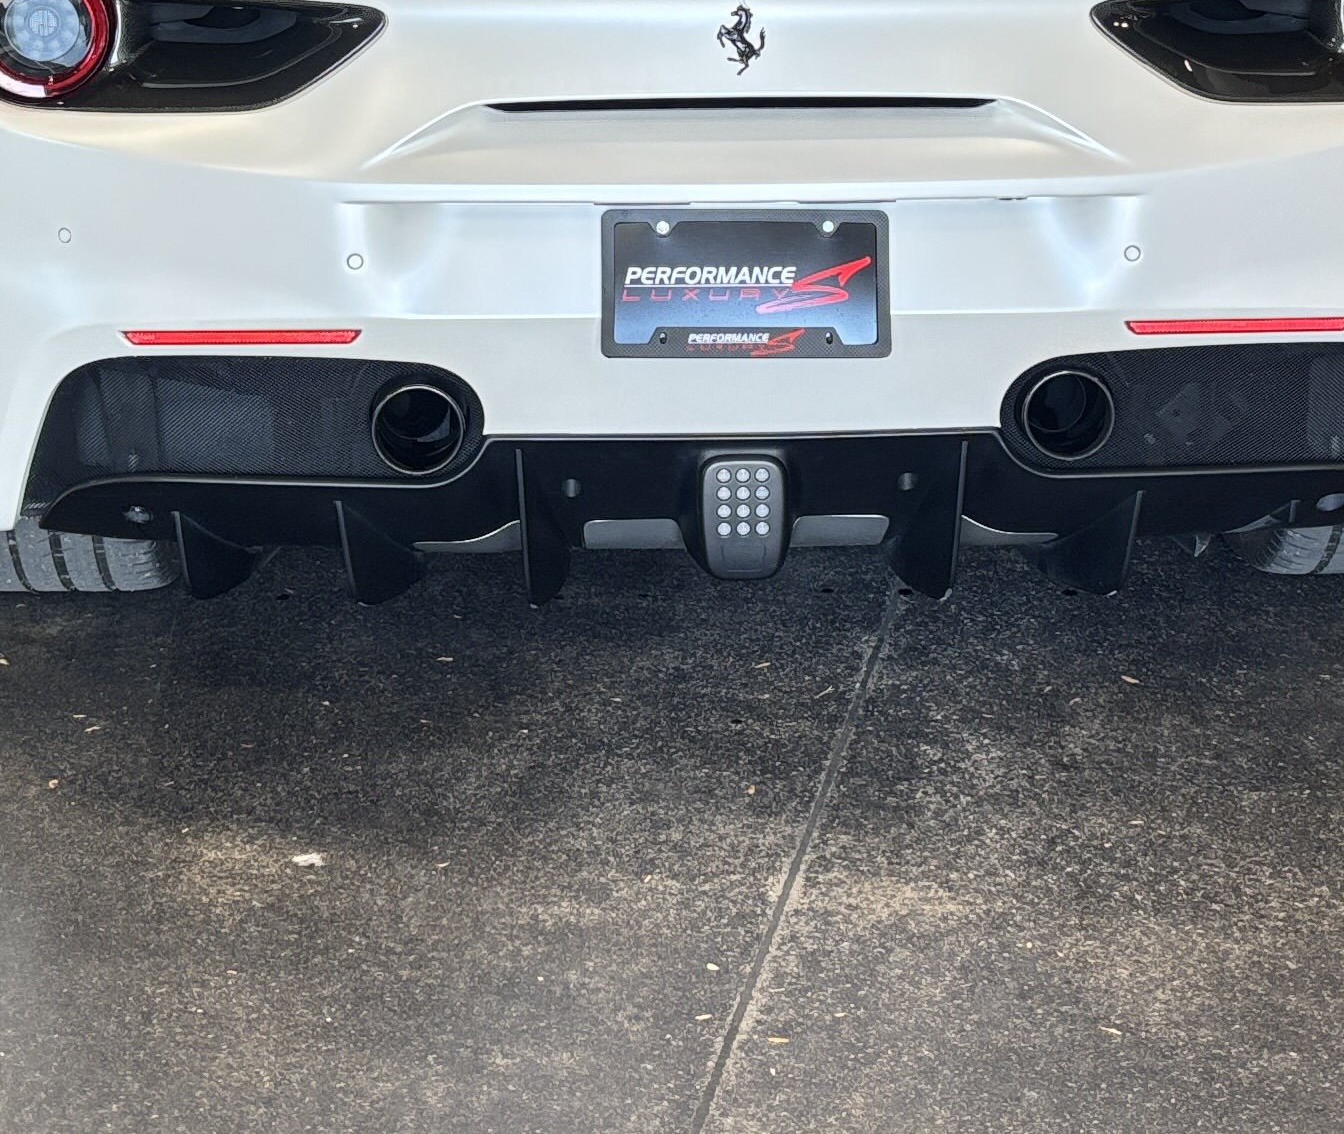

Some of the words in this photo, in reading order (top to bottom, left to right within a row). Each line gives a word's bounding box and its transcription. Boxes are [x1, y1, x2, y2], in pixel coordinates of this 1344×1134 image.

[624, 266, 797, 285] PERFORMANCE
[621, 288, 794, 302] LUXURY
[687, 332, 770, 344] PERFORMANCE
